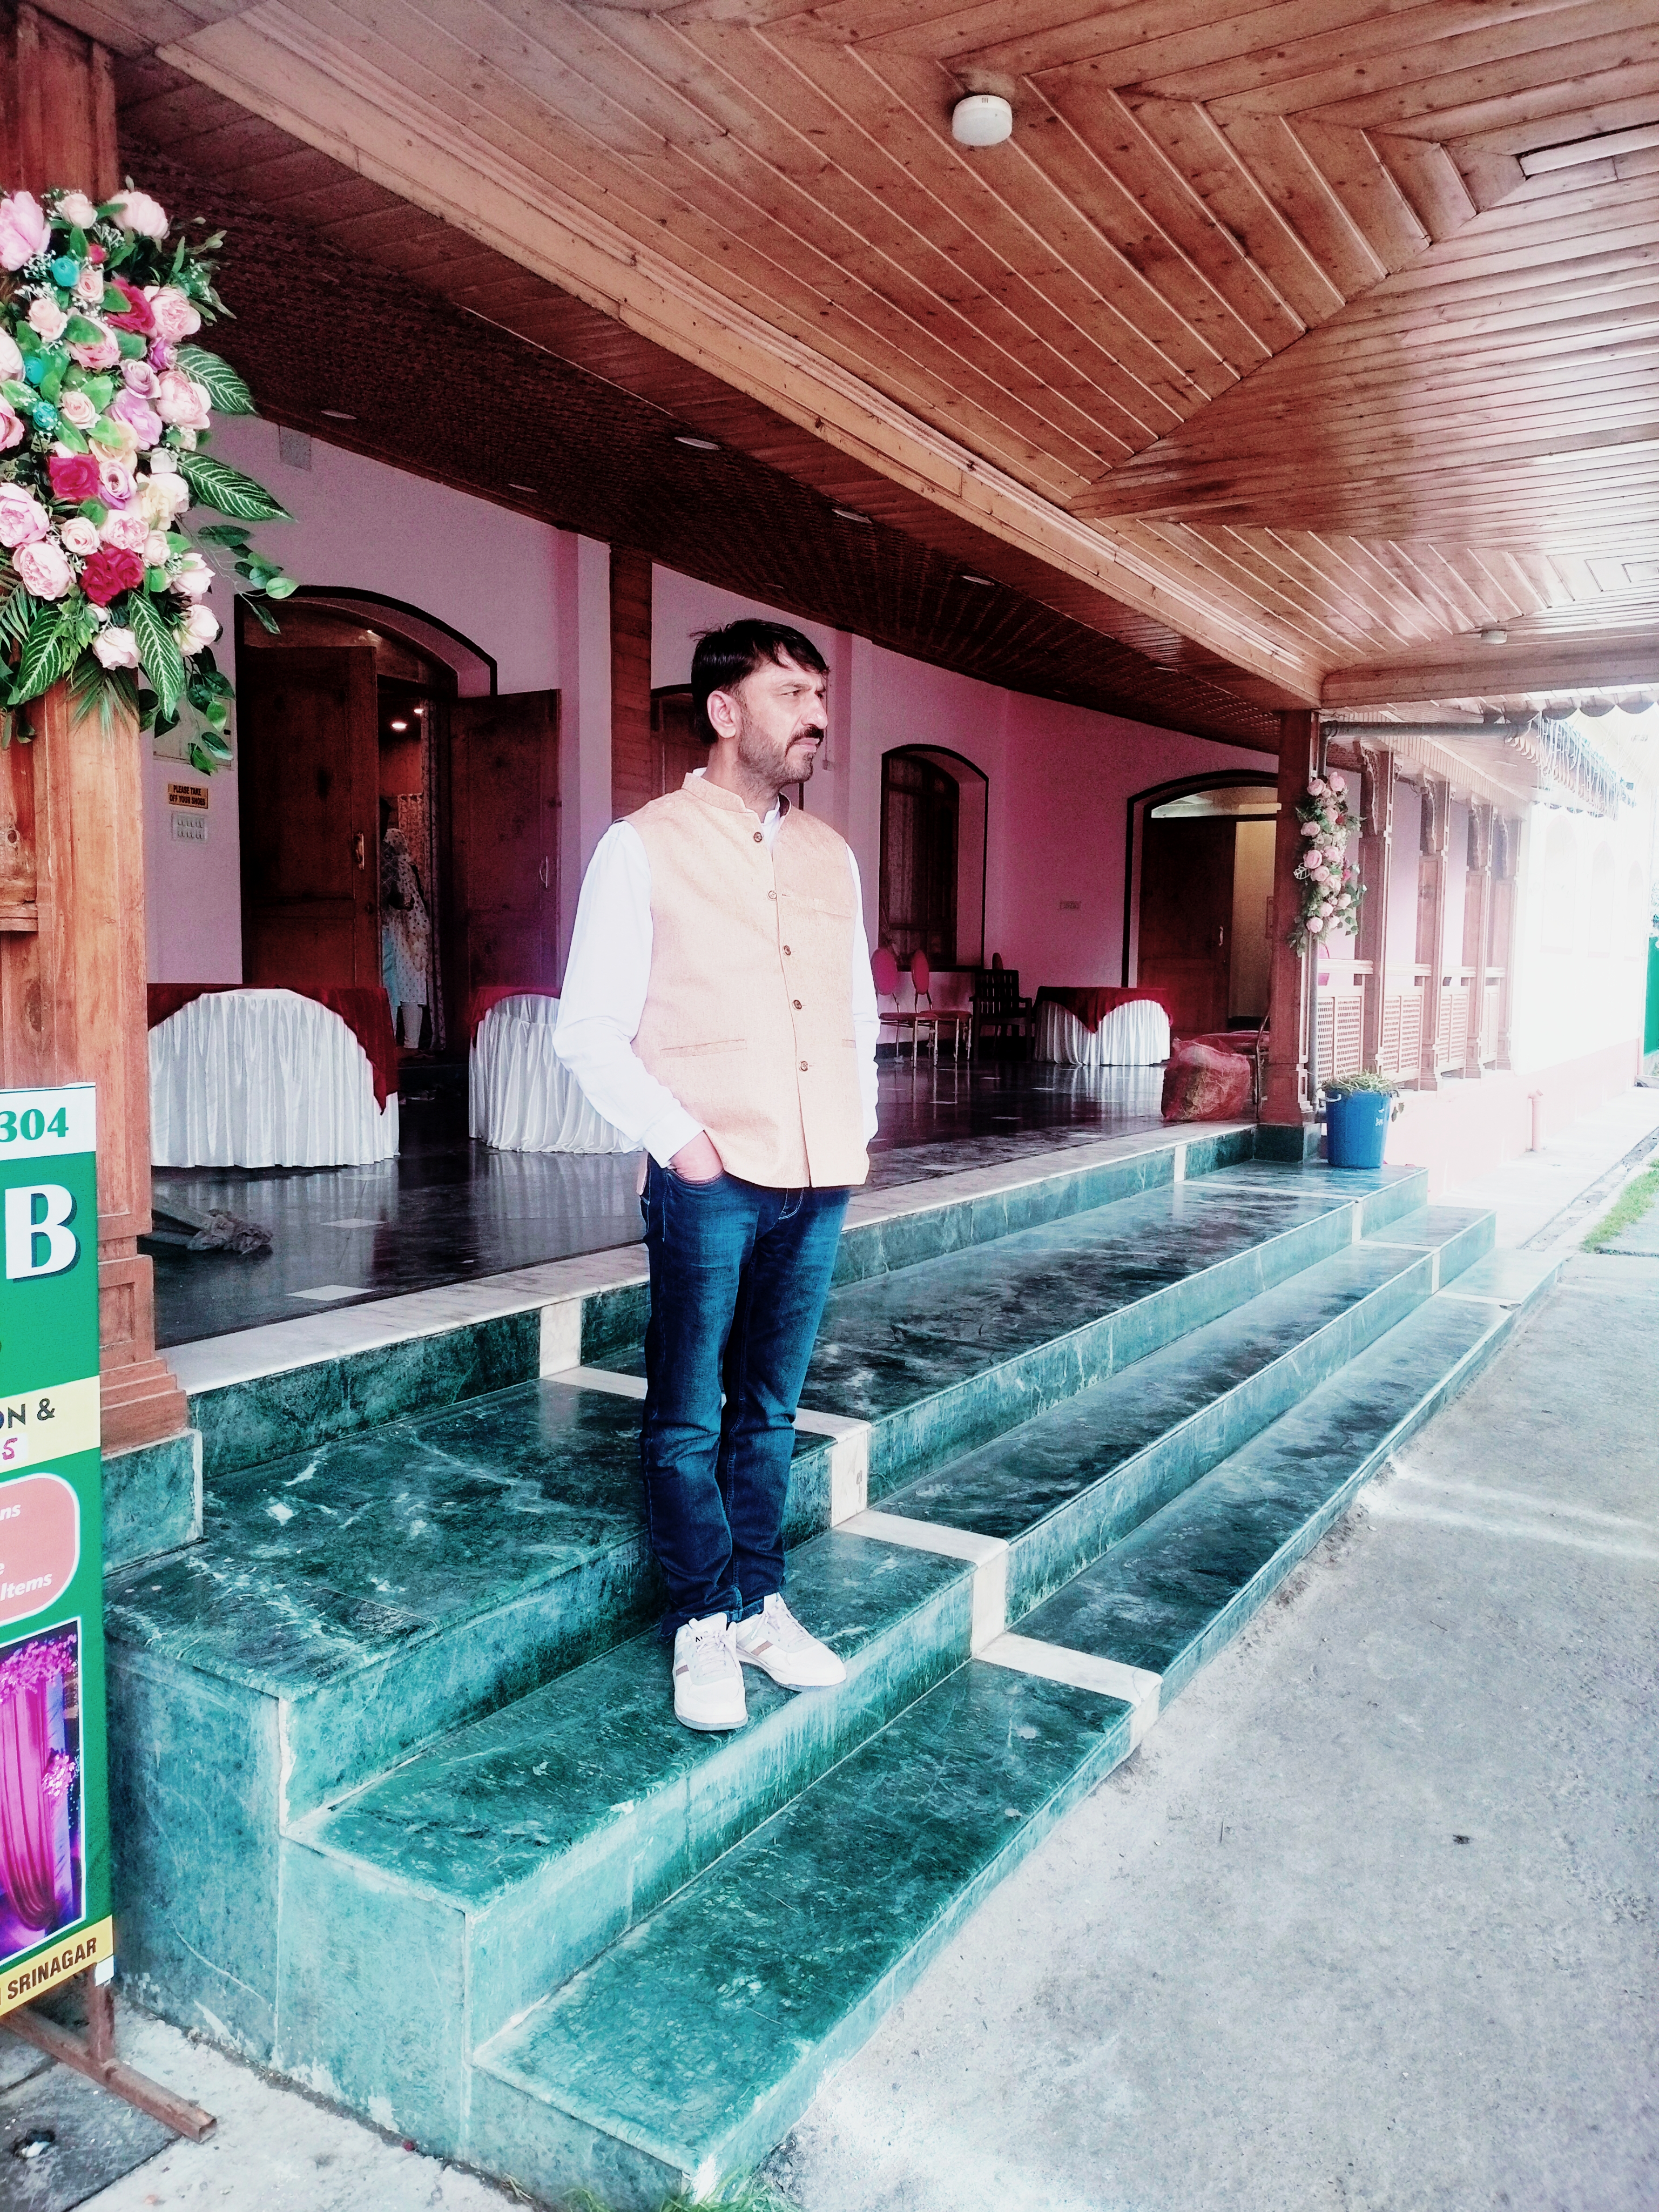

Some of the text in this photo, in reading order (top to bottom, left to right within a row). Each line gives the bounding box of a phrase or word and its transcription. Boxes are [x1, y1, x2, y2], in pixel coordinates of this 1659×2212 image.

[170, 794, 205, 806] OFF YOUR SHOES
[173, 785, 201, 796] PLEASE TAKE
[37, 1398, 56, 1421] &
[0, 1573, 52, 1602] Items
[8, 1937, 97, 2000] SRINAGAR
